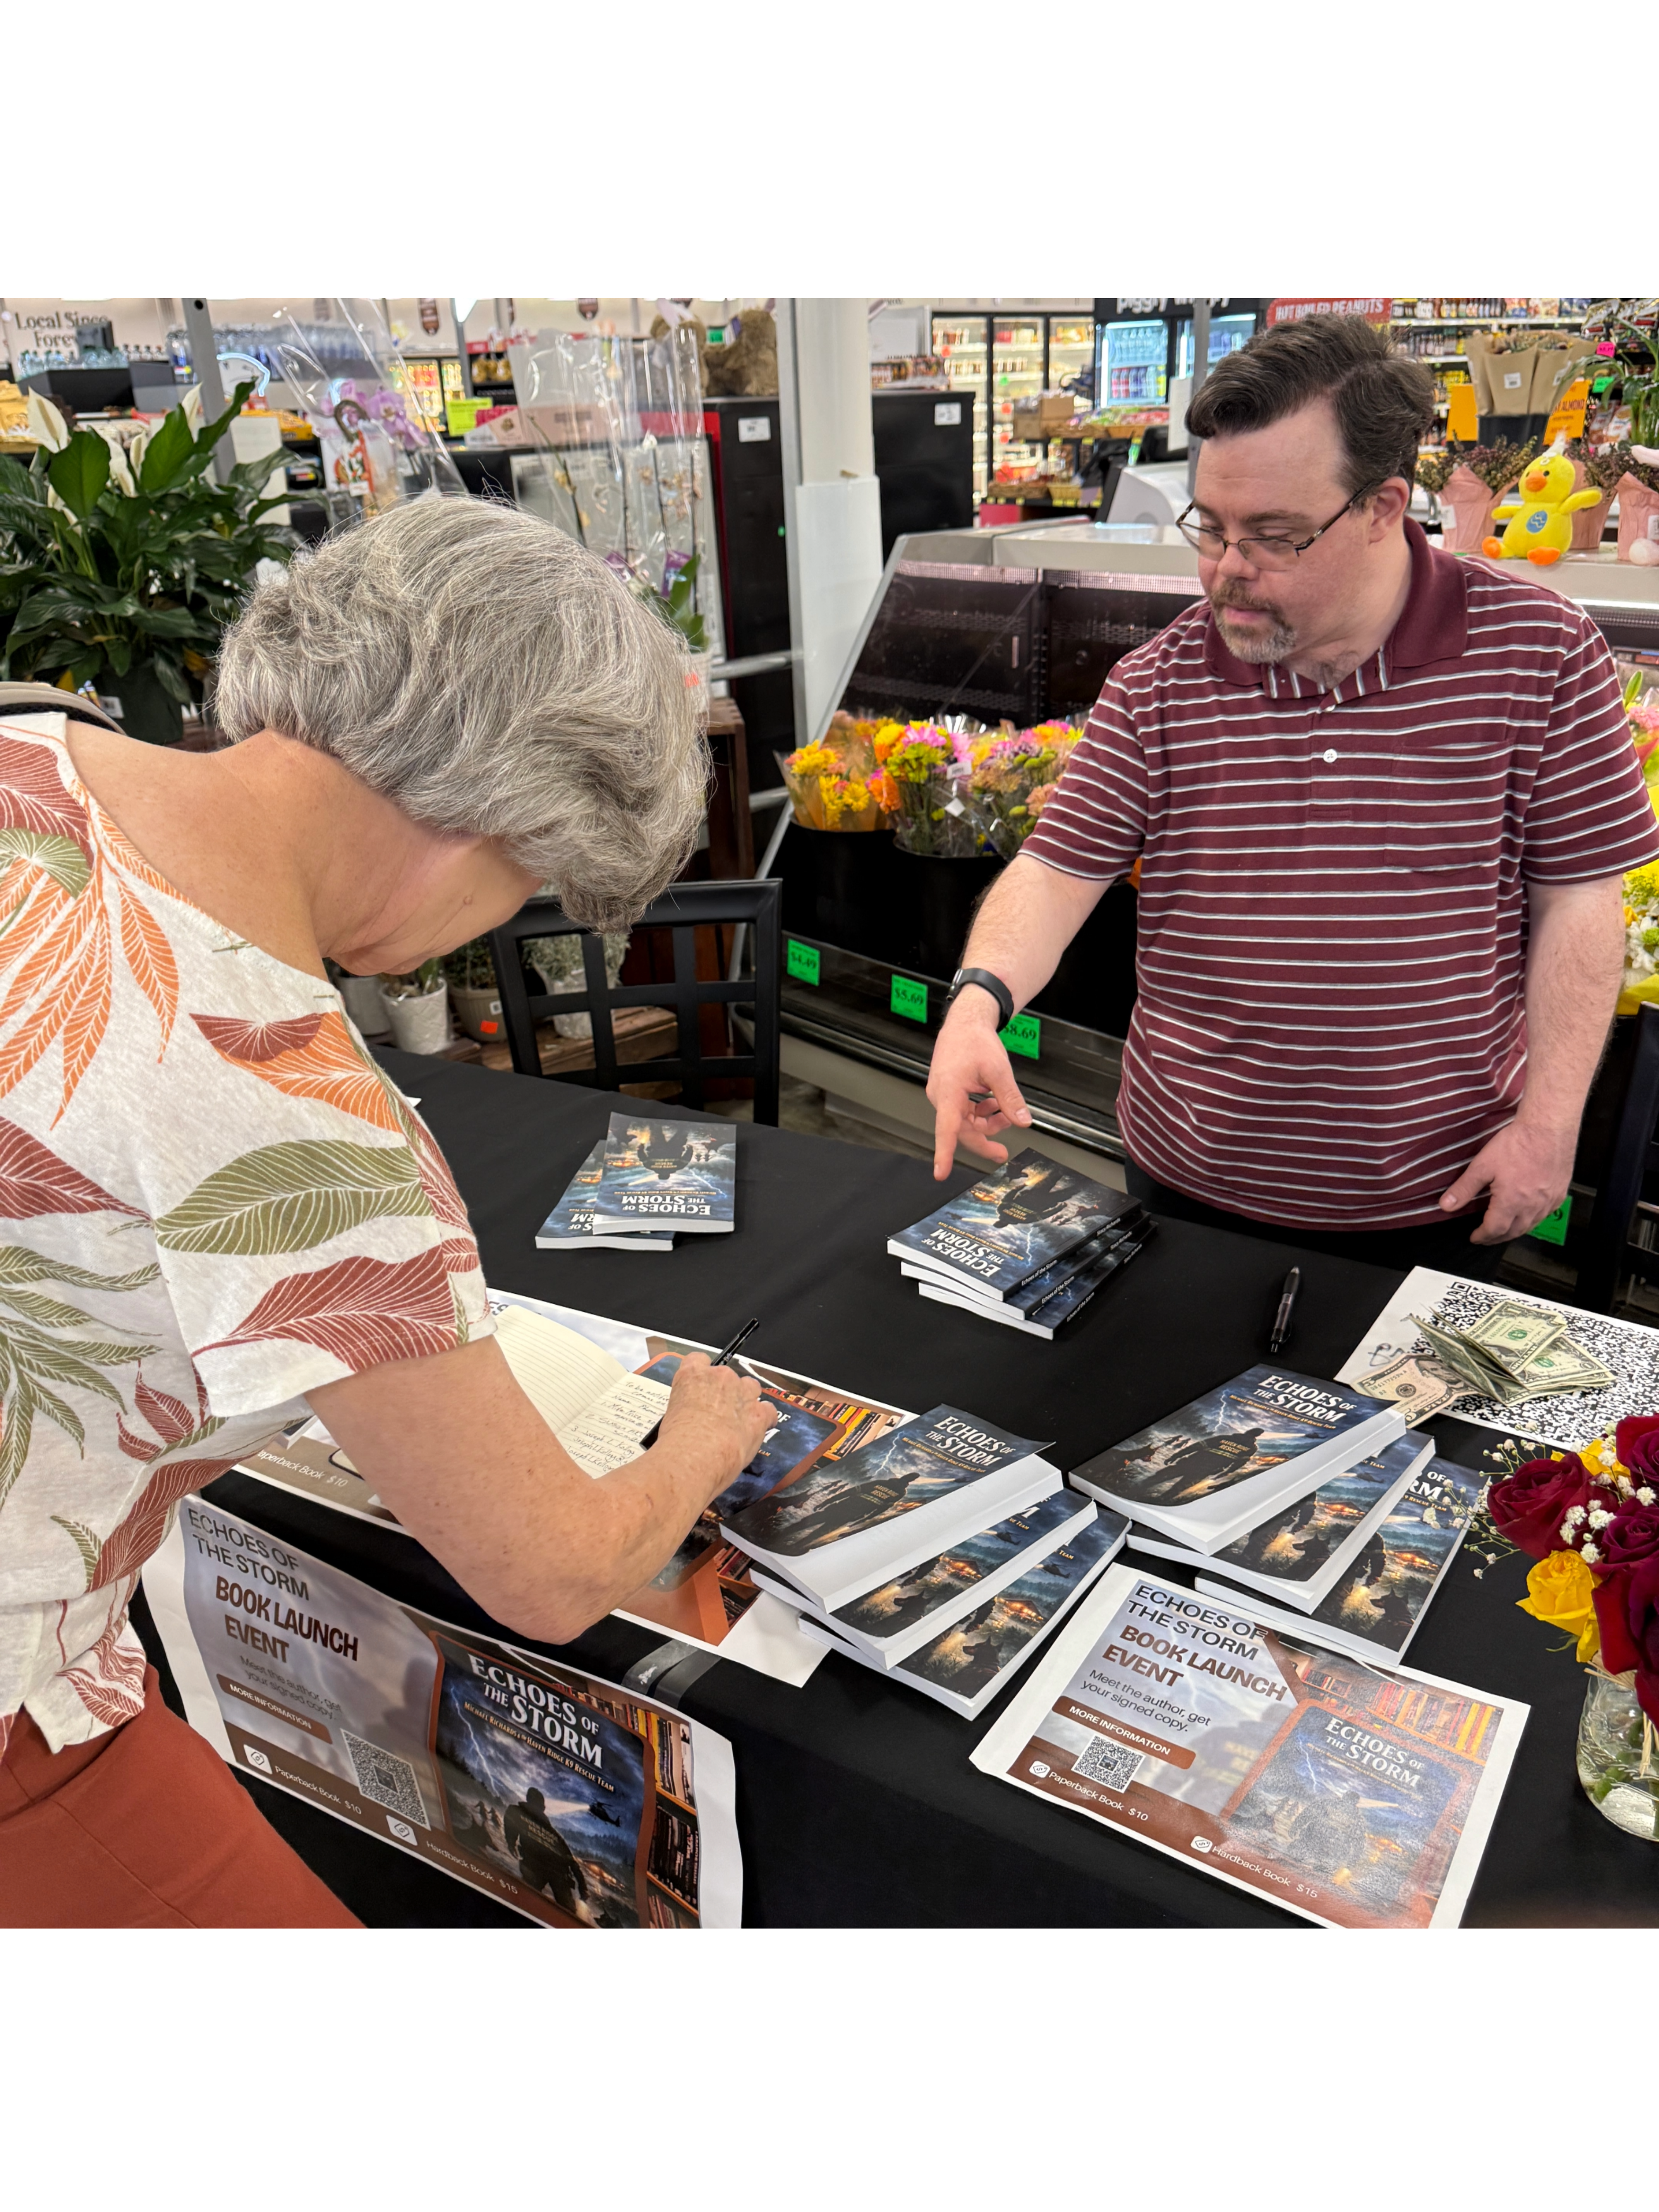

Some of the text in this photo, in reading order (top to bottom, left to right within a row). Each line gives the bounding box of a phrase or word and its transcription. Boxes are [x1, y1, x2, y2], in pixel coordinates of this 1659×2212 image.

[15, 311, 61, 330] Local
[1276, 305, 1294, 320] HOT
[895, 987, 924, 1006] $5.69
[621, 1195, 685, 1204] STORM
[638, 1204, 711, 1215] ECHOES
[930, 1228, 1005, 1264] THE STORM
[932, 1242, 1001, 1277] ECHOES
[1021, 1274, 1035, 1286] Echoes
[1046, 1259, 1058, 1270] Storm
[1041, 1291, 1054, 1304] Echoes
[1064, 1276, 1075, 1286] Storm
[1253, 1389, 1347, 1422] THE STORM
[1258, 1375, 1357, 1411] ECHOES OF
[925, 1430, 1003, 1466] THE STORM
[933, 1416, 1006, 1452] ECHOES
[1218, 1444, 1242, 1454] RESCUE
[257, 1449, 349, 1487] aperback Book $10
[1369, 1461, 1385, 1469] TEAM
[1427, 1471, 1446, 1482] OF
[870, 1489, 890, 1500] RESCUE
[1408, 1496, 1447, 1512] RESCUE TEAM
[188, 1508, 299, 1570] ECHOES OF
[1016, 1521, 1029, 1530] TEAM
[192, 1534, 309, 1601] THE STORM
[1059, 1550, 1074, 1560] TEAM
[216, 1575, 358, 1662] BOOK LAUNCH
[1127, 1600, 1259, 1661] THE STORM
[1134, 1585, 1268, 1640] ECHOES OF
[225, 1614, 289, 1663] EVENT
[240, 1655, 342, 1713] Meet the author, get
[1102, 1644, 1184, 1687] EVENT
[1119, 1625, 1288, 1701] BOOK LAUNCH
[230, 1684, 312, 1729] MORE INFORMATION
[244, 1669, 337, 1720] your signed copy.
[468, 1653, 599, 1735] ECHOES OF
[1080, 1681, 1188, 1732] your signed copy.
[1089, 1669, 1212, 1726] Meet the author, get
[464, 1702, 488, 1721] MICHAEL
[489, 1716, 517, 1737] RICHARDS
[527, 1736, 546, 1753] HAVEN
[547, 1747, 564, 1764] RIDGE
[565, 1758, 574, 1768] K9
[574, 1763, 596, 1782] RESCUE
[597, 1776, 615, 1793] TEAM
[484, 1682, 603, 1769] THE STORM
[1069, 1705, 1171, 1755] MORE INFORMATION
[1324, 1717, 1425, 1770] ECHOES OF
[1326, 1735, 1347, 1750] THE
[1345, 1744, 1421, 1788] STORM
[275, 1765, 362, 1815] Paperback Book $10
[1049, 1771, 1149, 1821] Paperback Book $10
[426, 1840, 518, 1894] Hardback Book $15
[1212, 1846, 1318, 1898] Hardback Book $15
